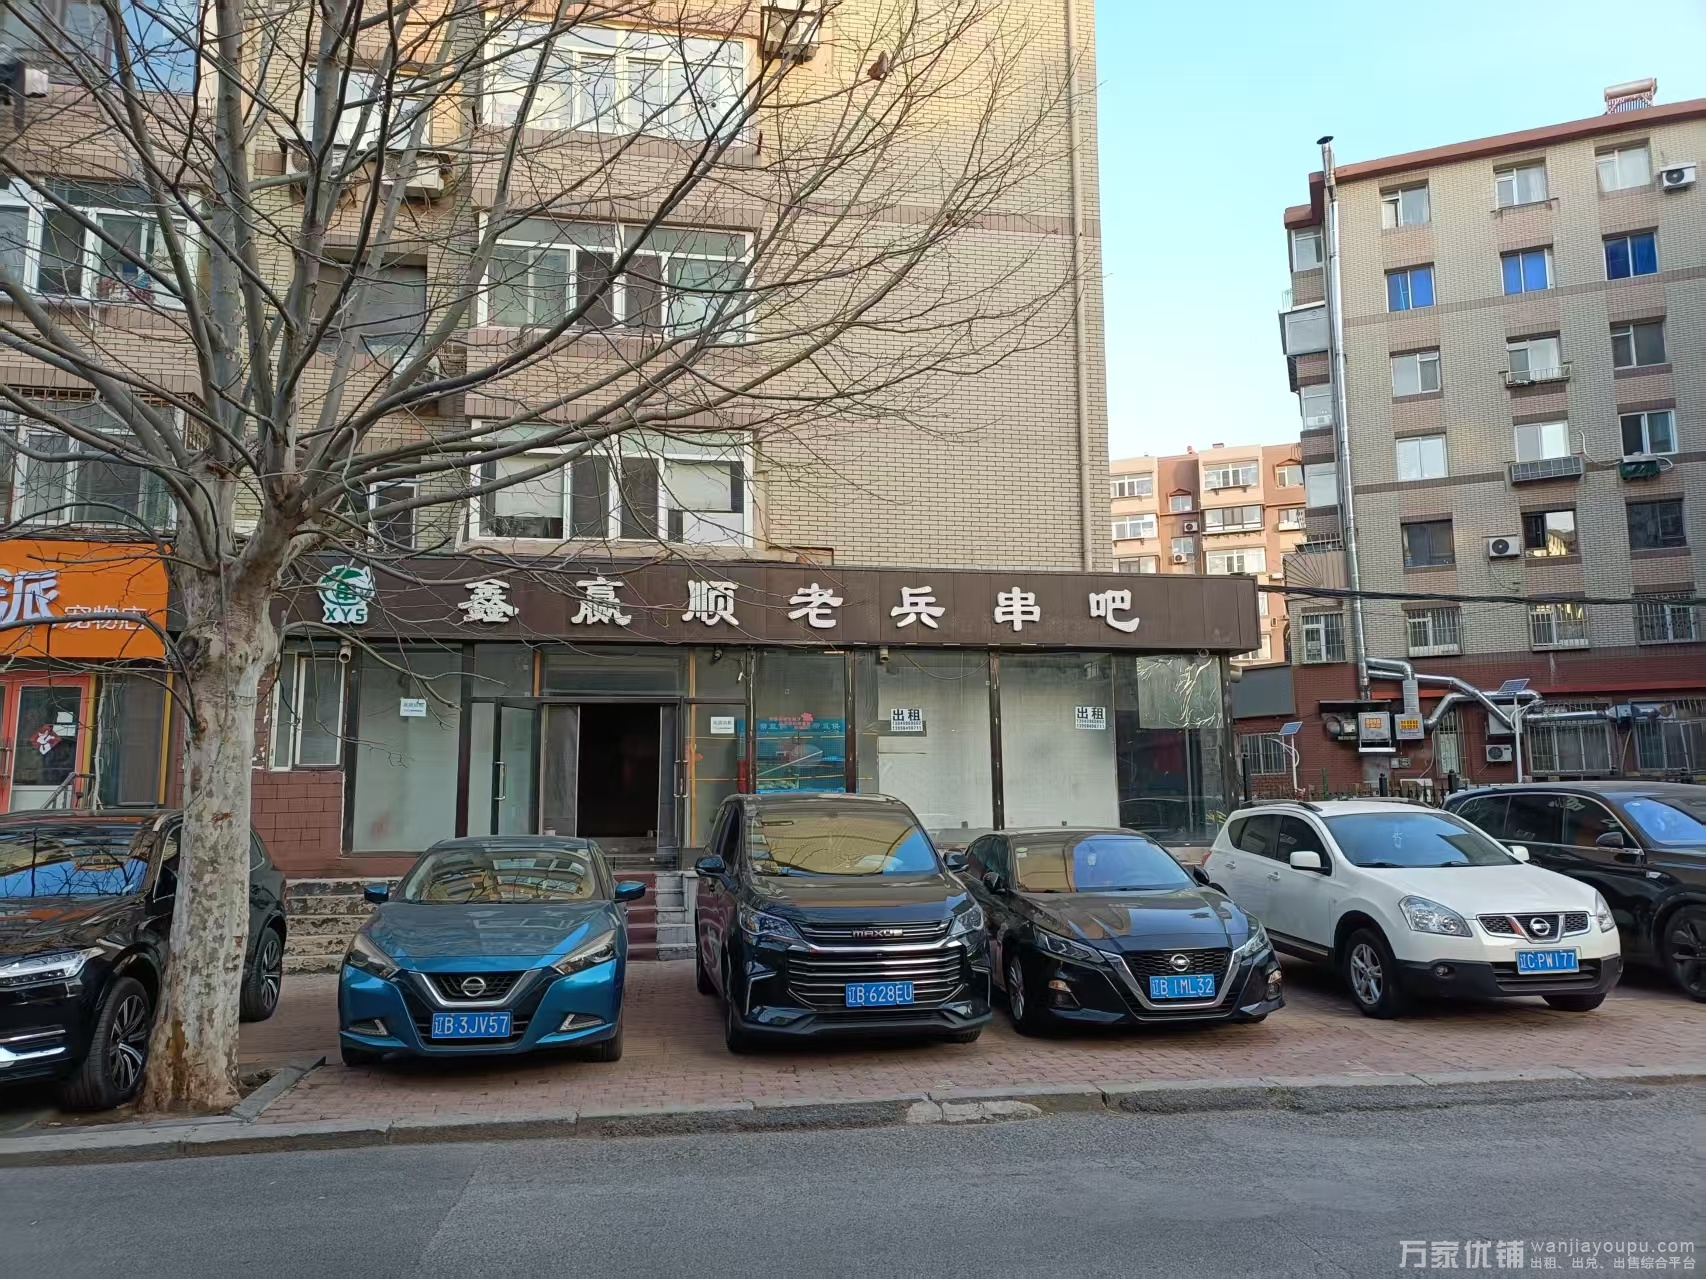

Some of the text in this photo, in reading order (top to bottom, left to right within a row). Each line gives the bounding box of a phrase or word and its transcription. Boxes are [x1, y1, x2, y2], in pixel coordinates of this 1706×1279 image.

[325, 607, 365, 621] XYS
[892, 708, 920, 721] 出租
[1076, 706, 1104, 719] 出租
